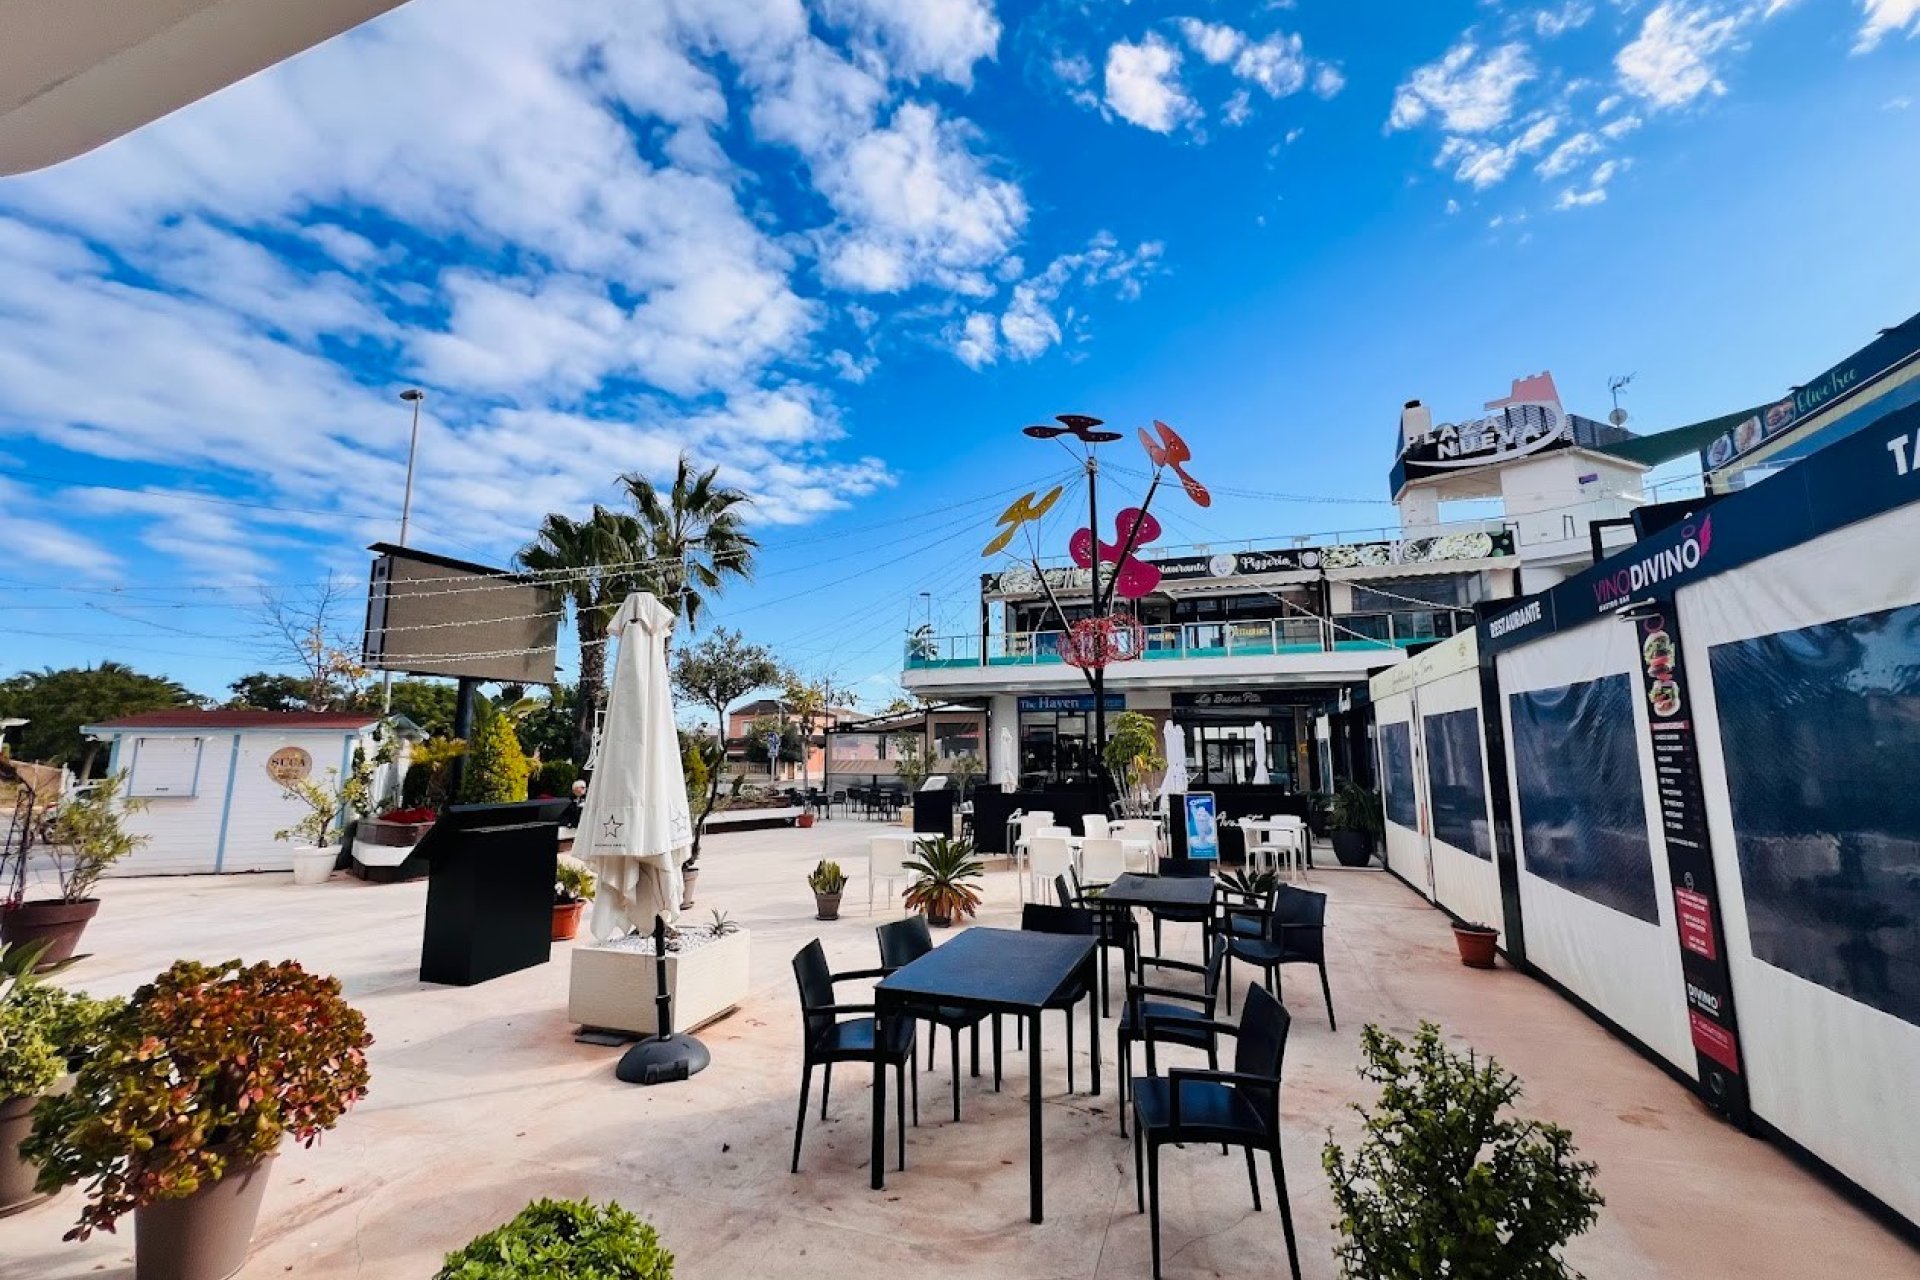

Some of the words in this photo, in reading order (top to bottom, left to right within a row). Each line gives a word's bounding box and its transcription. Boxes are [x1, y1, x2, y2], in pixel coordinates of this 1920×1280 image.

[1404, 416, 1500, 452] PLAZA
[1437, 424, 1541, 460] NUEVA
[1489, 601, 1542, 639] RESTAURANTE
[1021, 700, 1036, 709] The
[1039, 696, 1080, 709] Haven
[1686, 982, 1719, 1010] DIVINO
